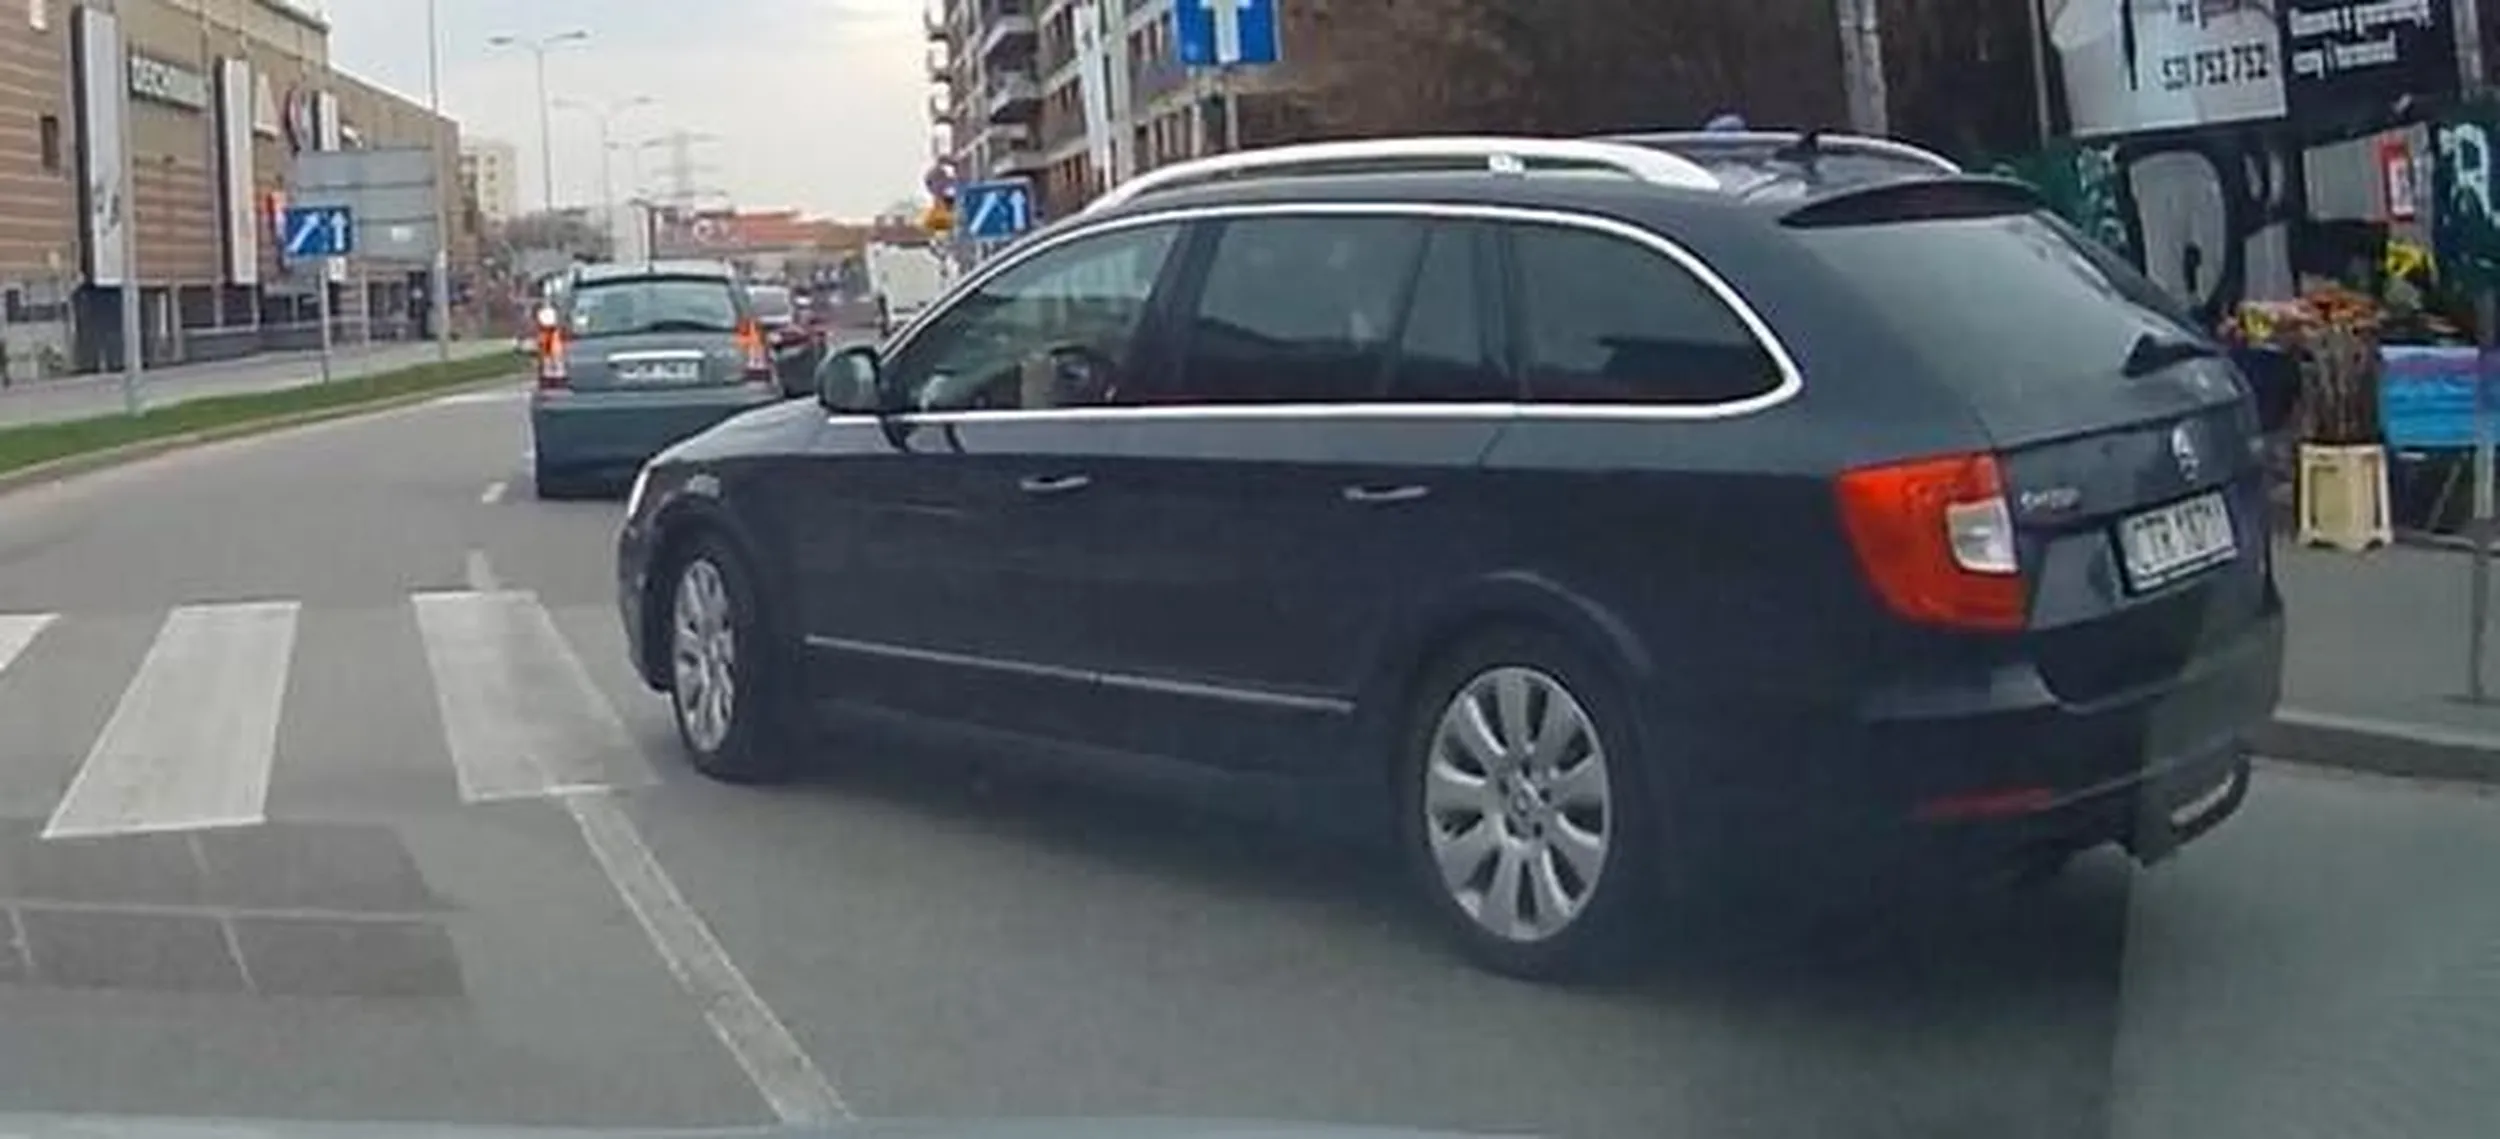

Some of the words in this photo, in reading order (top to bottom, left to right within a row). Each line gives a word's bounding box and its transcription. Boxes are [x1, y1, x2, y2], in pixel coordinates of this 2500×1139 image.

[2195, 49, 2228, 85] 752
[2232, 43, 2268, 80] 752
[2131, 514, 2177, 568] CTR
